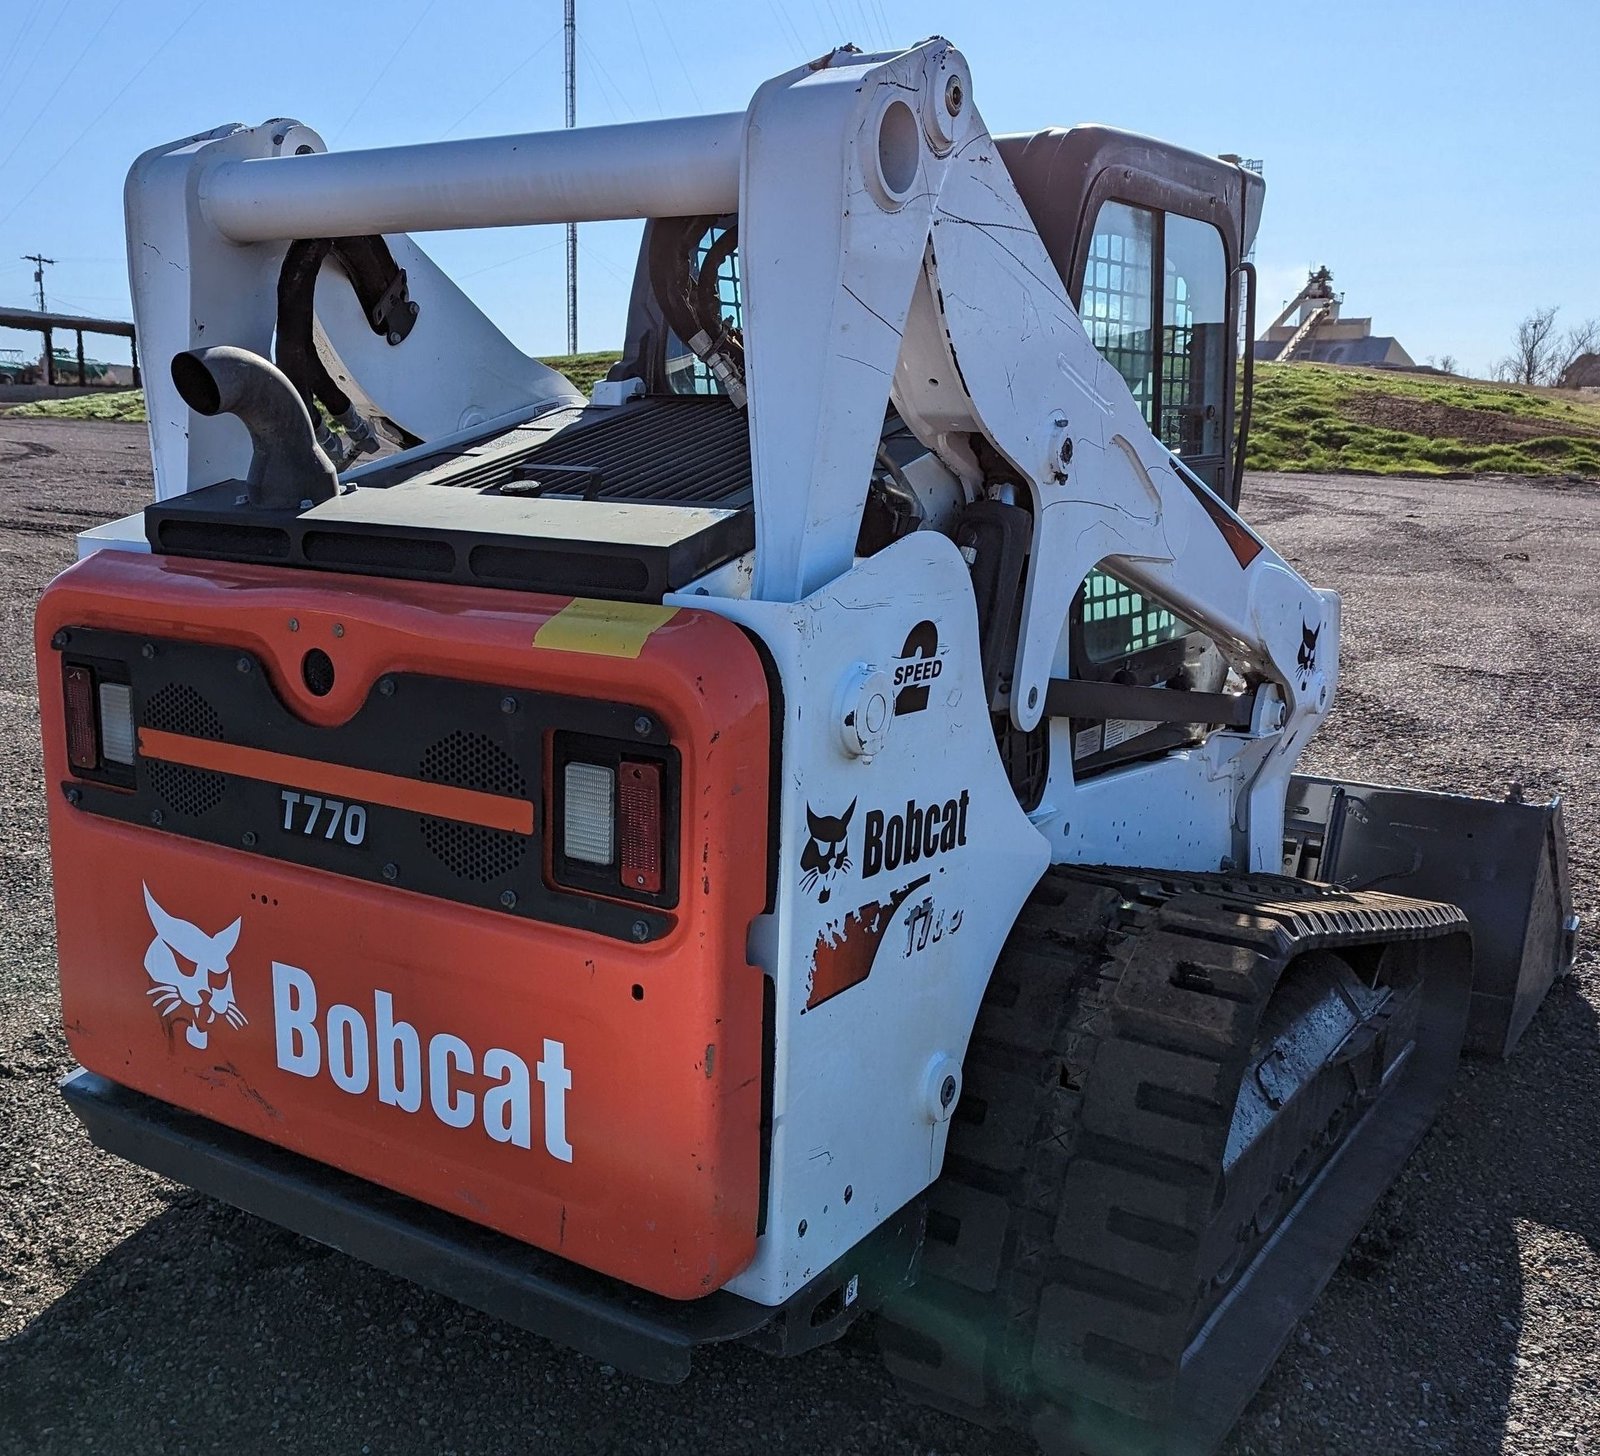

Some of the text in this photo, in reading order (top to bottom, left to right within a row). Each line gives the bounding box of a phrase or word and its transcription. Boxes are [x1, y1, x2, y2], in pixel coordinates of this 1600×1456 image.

[893, 660, 943, 686] SPEED
[895, 620, 938, 716] 2
[281, 790, 367, 845] T770
[862, 789, 970, 879] Bobcat
[271, 961, 573, 1163] Bobcat
